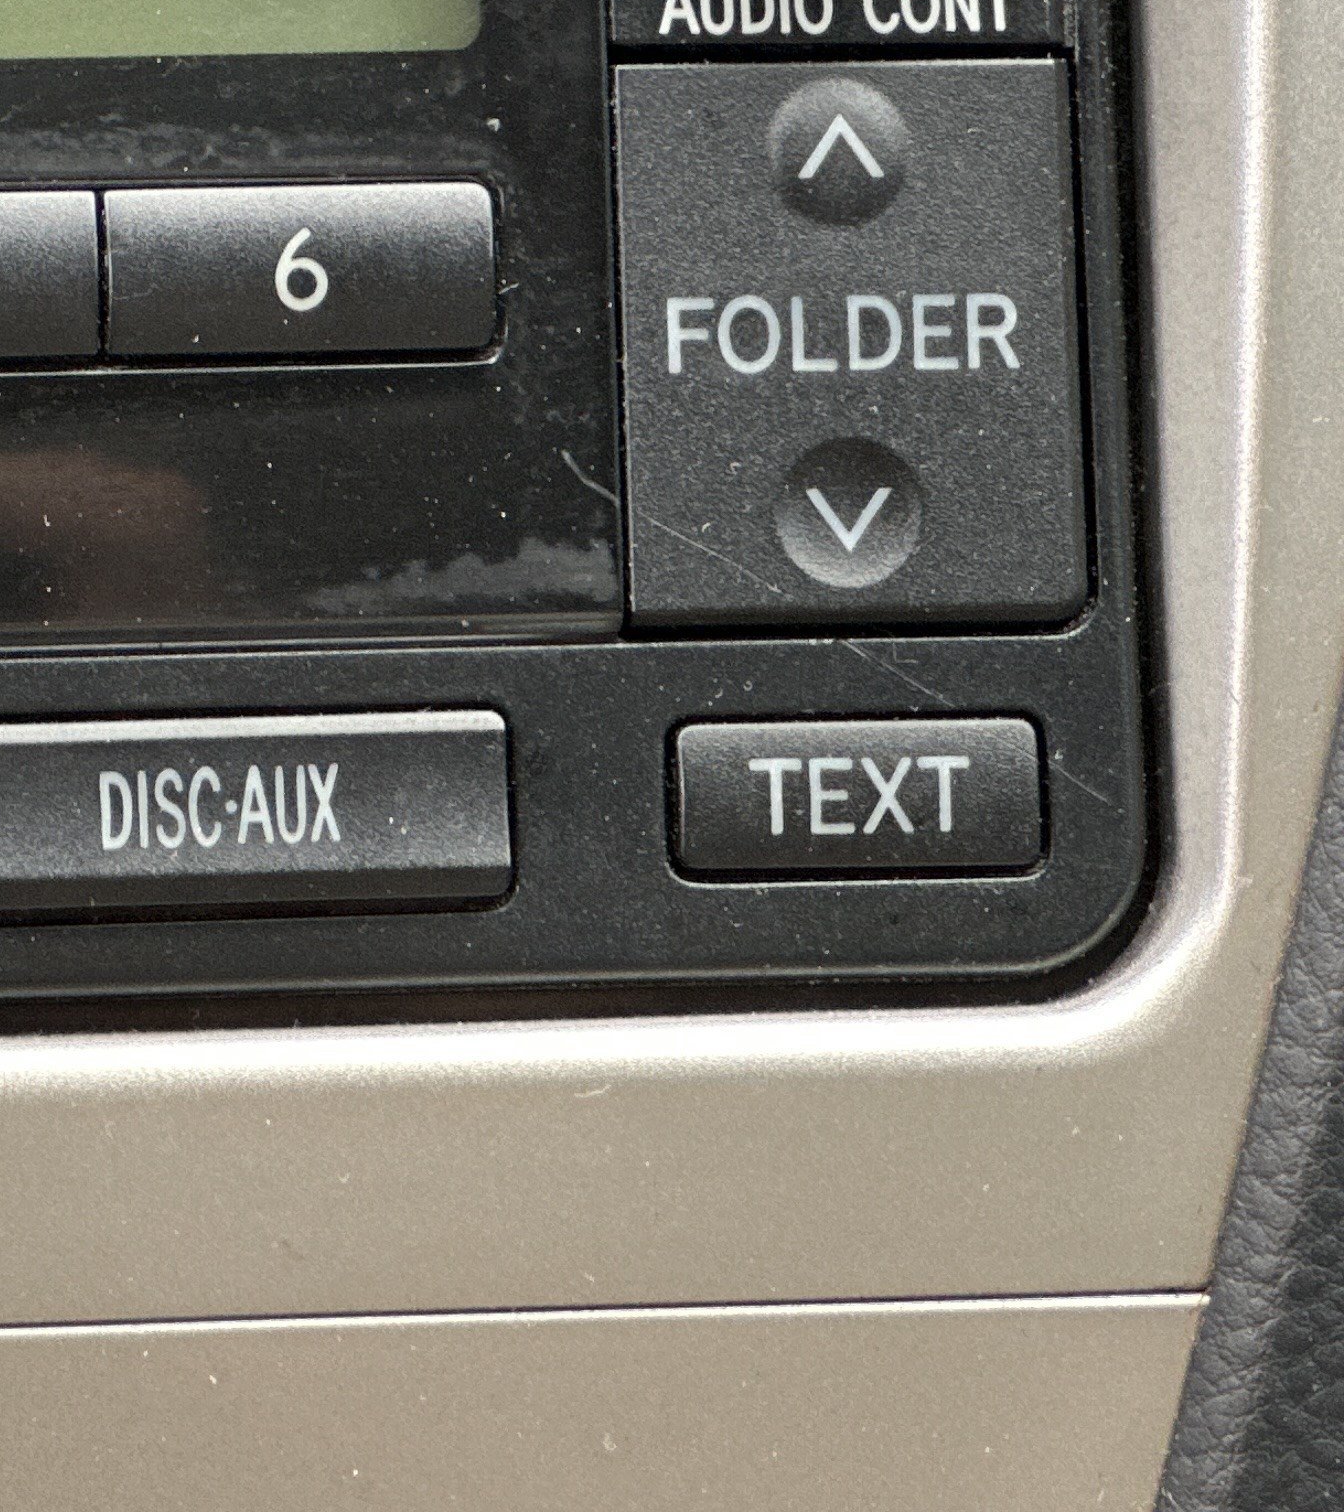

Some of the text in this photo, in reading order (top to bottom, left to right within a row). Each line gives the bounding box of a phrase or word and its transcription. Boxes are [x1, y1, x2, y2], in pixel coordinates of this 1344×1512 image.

[274, 228, 329, 313] 6
[666, 295, 1020, 373] FOLDER
[750, 756, 970, 835] TEXT
